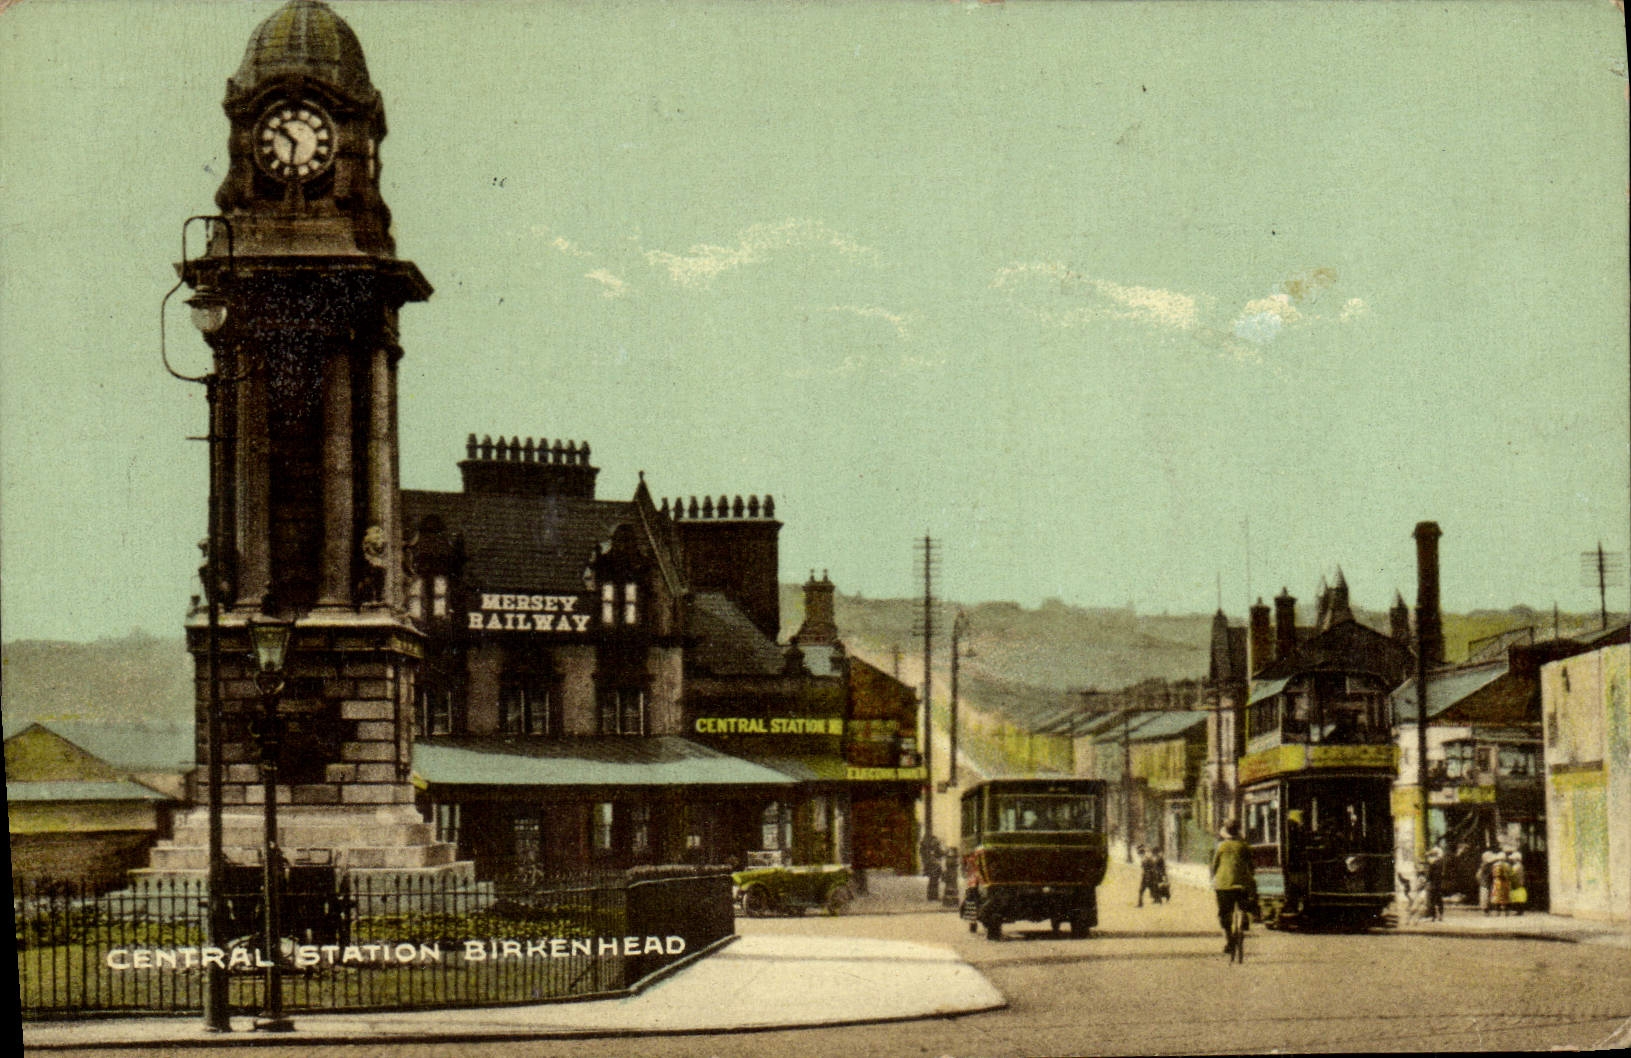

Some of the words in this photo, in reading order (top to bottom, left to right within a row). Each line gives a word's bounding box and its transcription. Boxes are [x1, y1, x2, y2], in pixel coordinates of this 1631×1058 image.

[481, 593, 578, 611] MERSEY
[467, 612, 591, 632] RAILWAY
[696, 718, 768, 733] CENTRAL
[770, 718, 825, 734] STATION
